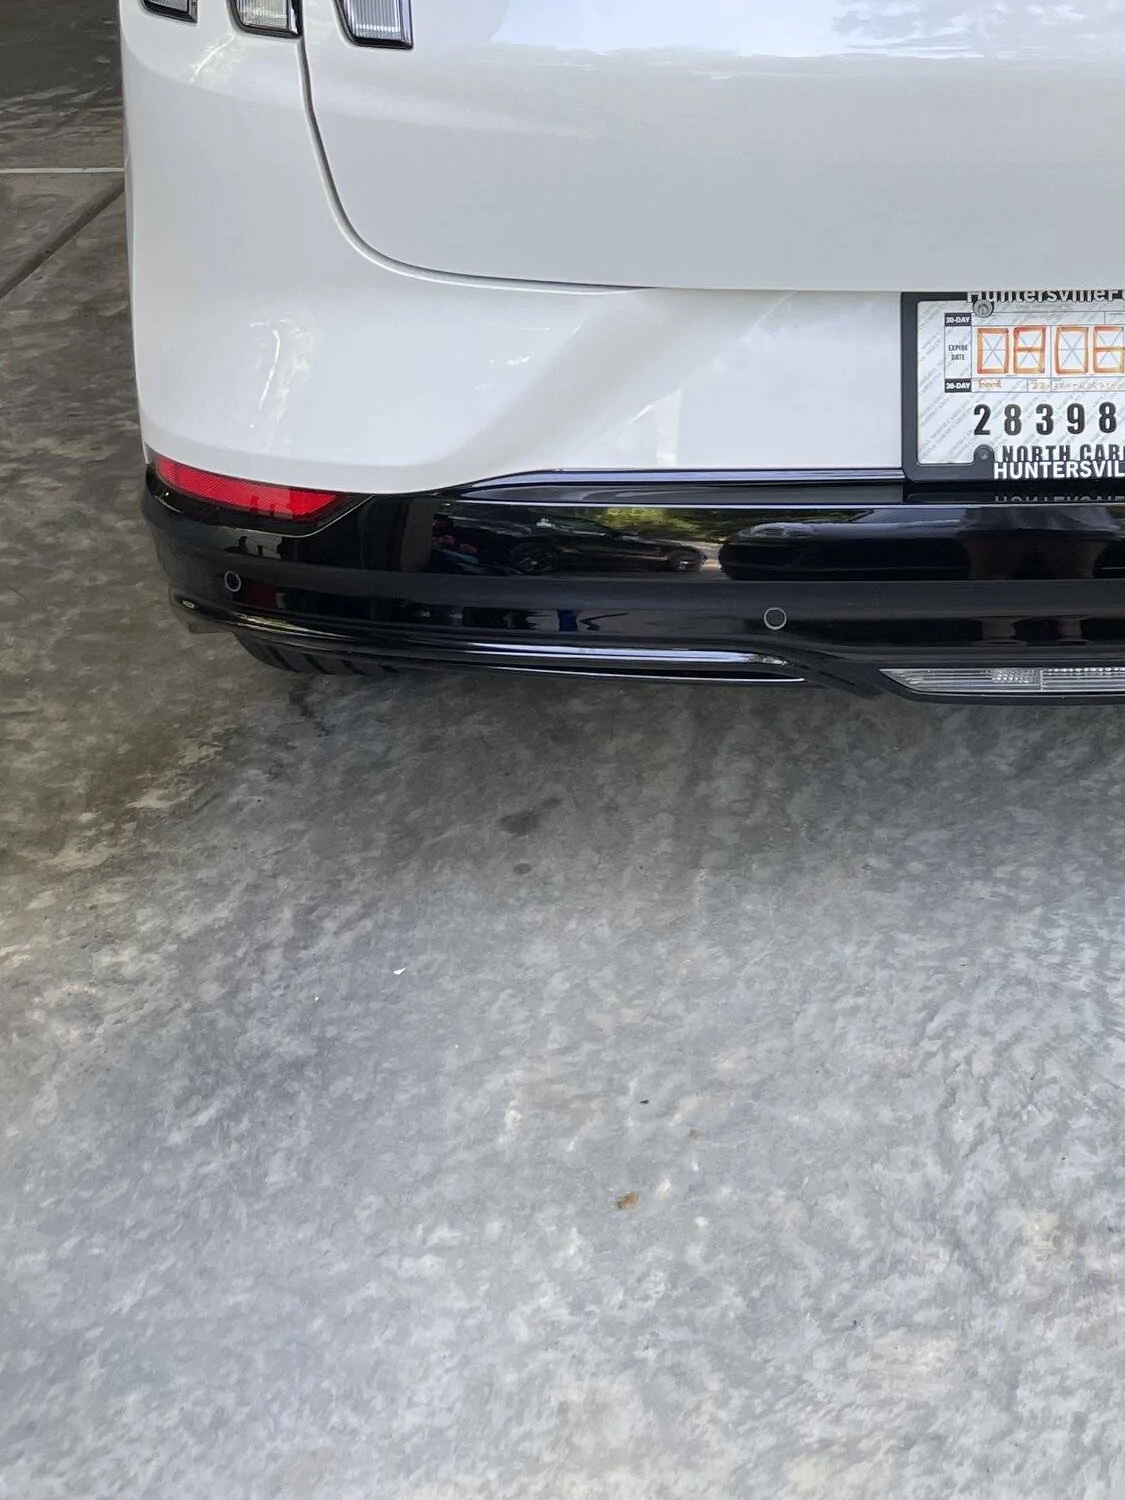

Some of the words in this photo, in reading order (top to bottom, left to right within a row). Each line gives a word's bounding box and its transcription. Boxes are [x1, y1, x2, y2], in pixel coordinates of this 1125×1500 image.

[945, 315, 970, 324] 30-DAY
[945, 382, 971, 390] 30-DAY
[1002, 444, 1071, 462] NORTH
